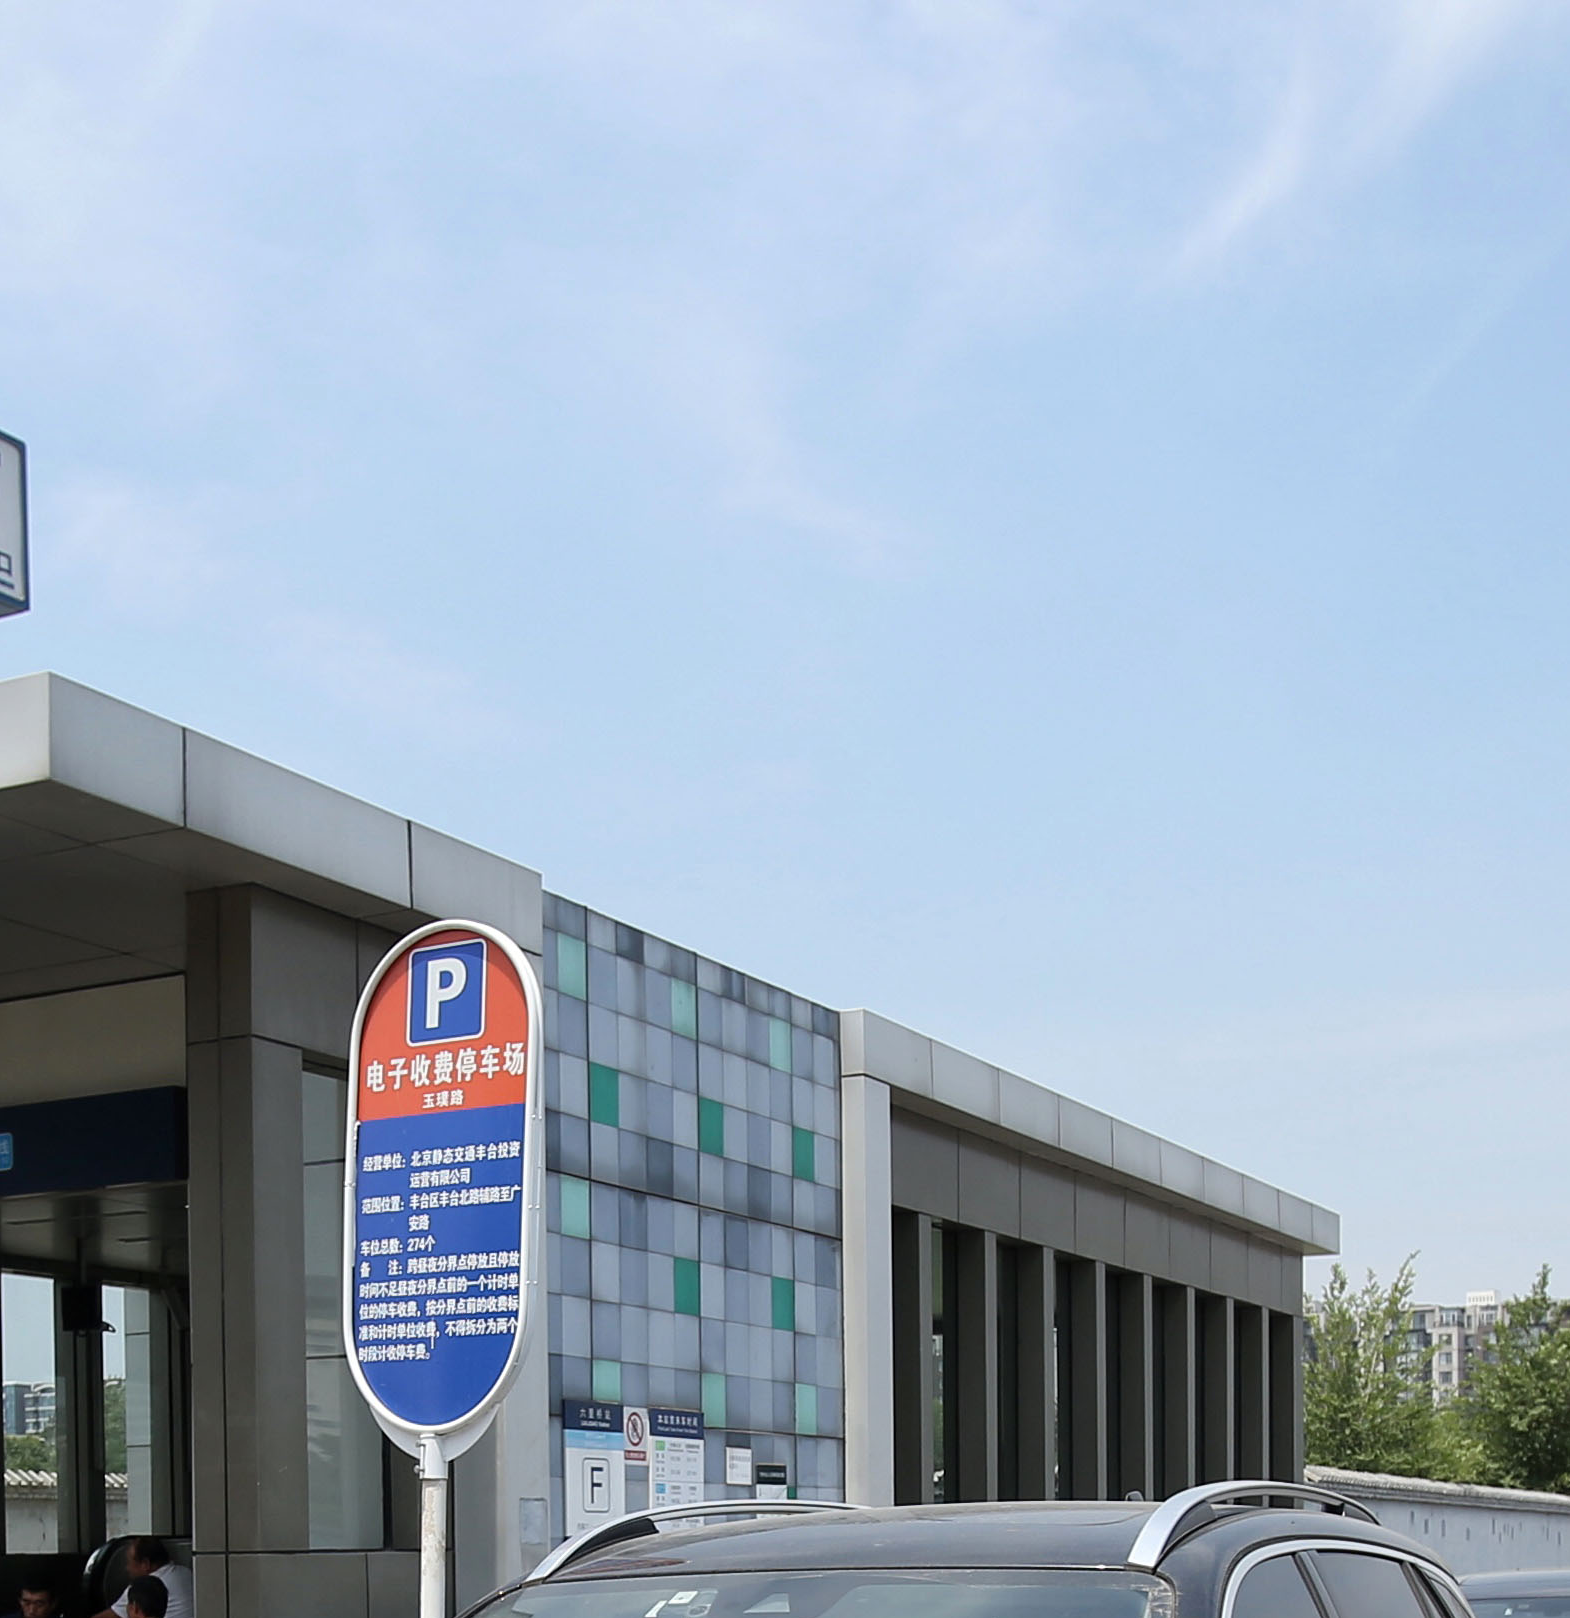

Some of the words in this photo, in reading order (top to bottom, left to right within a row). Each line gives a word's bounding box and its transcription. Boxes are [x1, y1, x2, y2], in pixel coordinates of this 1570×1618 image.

[425, 956, 467, 1029] P
[366, 1042, 525, 1093] 电子收费停车场
[409, 1167, 471, 1188] 运营有限公司
[408, 1214, 430, 1232] 安路
[590, 1466, 604, 1504] F
